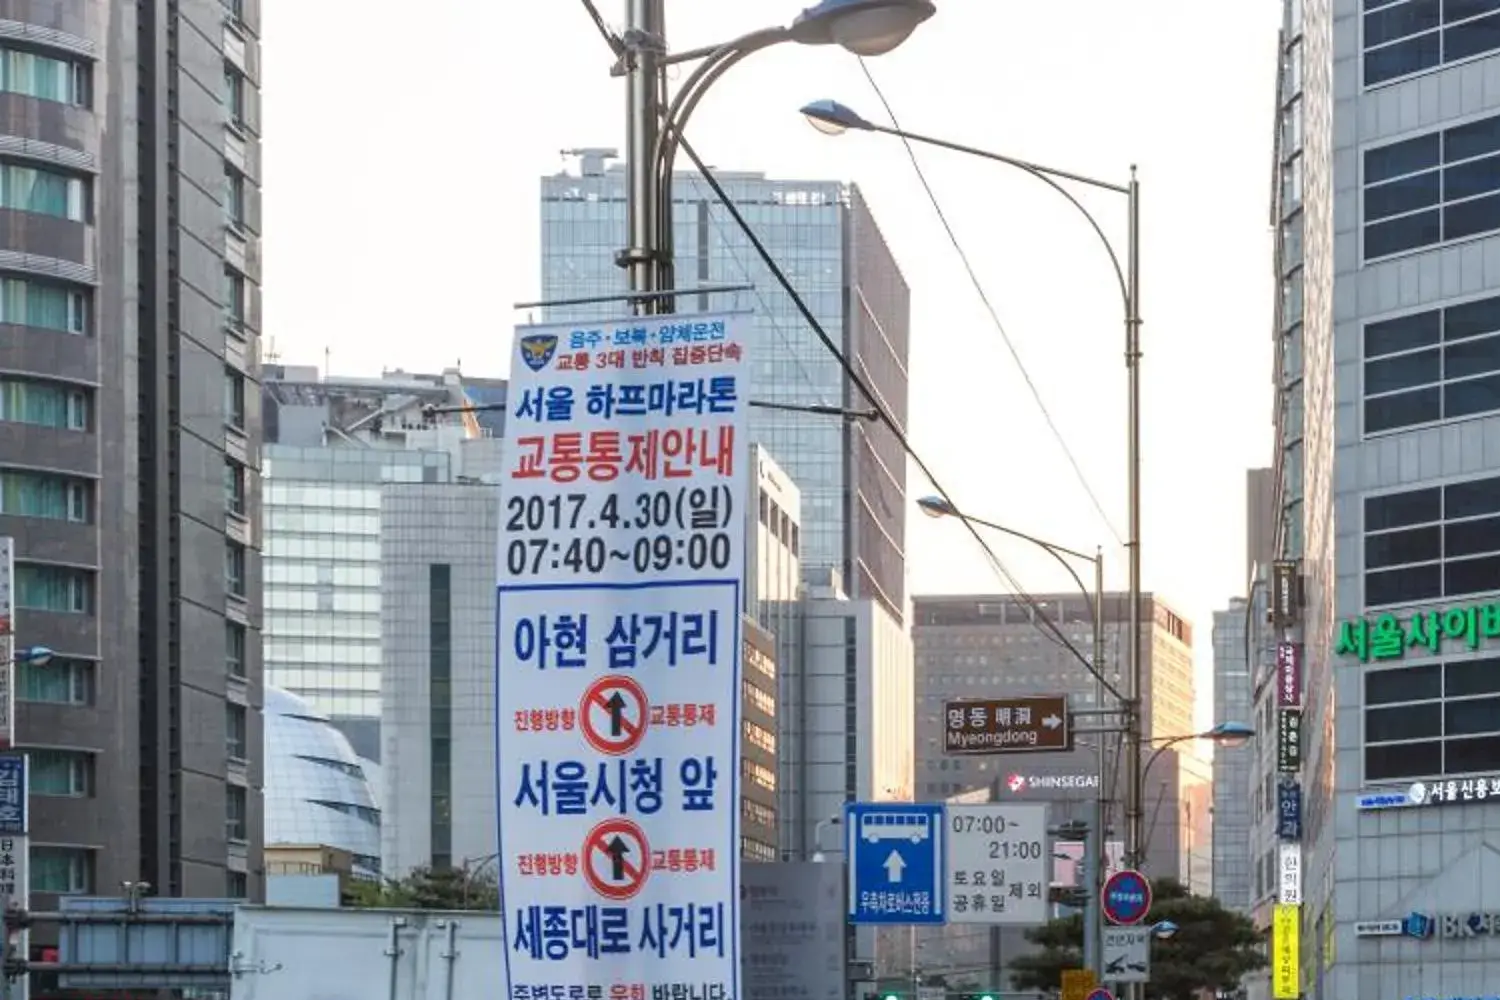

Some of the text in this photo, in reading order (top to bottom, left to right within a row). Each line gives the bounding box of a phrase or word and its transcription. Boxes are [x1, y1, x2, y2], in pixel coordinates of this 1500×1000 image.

[555, 352, 591, 371] 교통
[595, 350, 625, 370] 3대
[673, 342, 742, 366] 집중단속
[515, 375, 737, 422] 서울 하프마라톤
[511, 425, 735, 483] 교통통제안내
[506, 485, 733, 531] 2017.4.30(일)
[507, 533, 731, 575] 07:40~09:00
[514, 609, 718, 670] 아현 삼거리
[514, 703, 716, 732] 진행방향 교통통제
[948, 706, 988, 729] 명동
[948, 730, 1038, 747] Myeongdong
[514, 755, 718, 816] 서울시청 앞
[517, 848, 716, 876] 진행방향 교통통제
[989, 841, 1041, 859] 21:00
[954, 869, 1005, 887] 토요일
[1009, 882, 1041, 899] 제외
[953, 893, 1005, 913] 공휴일
[513, 904, 631, 961] 세종대로
[638, 902, 725, 959] 사거리
